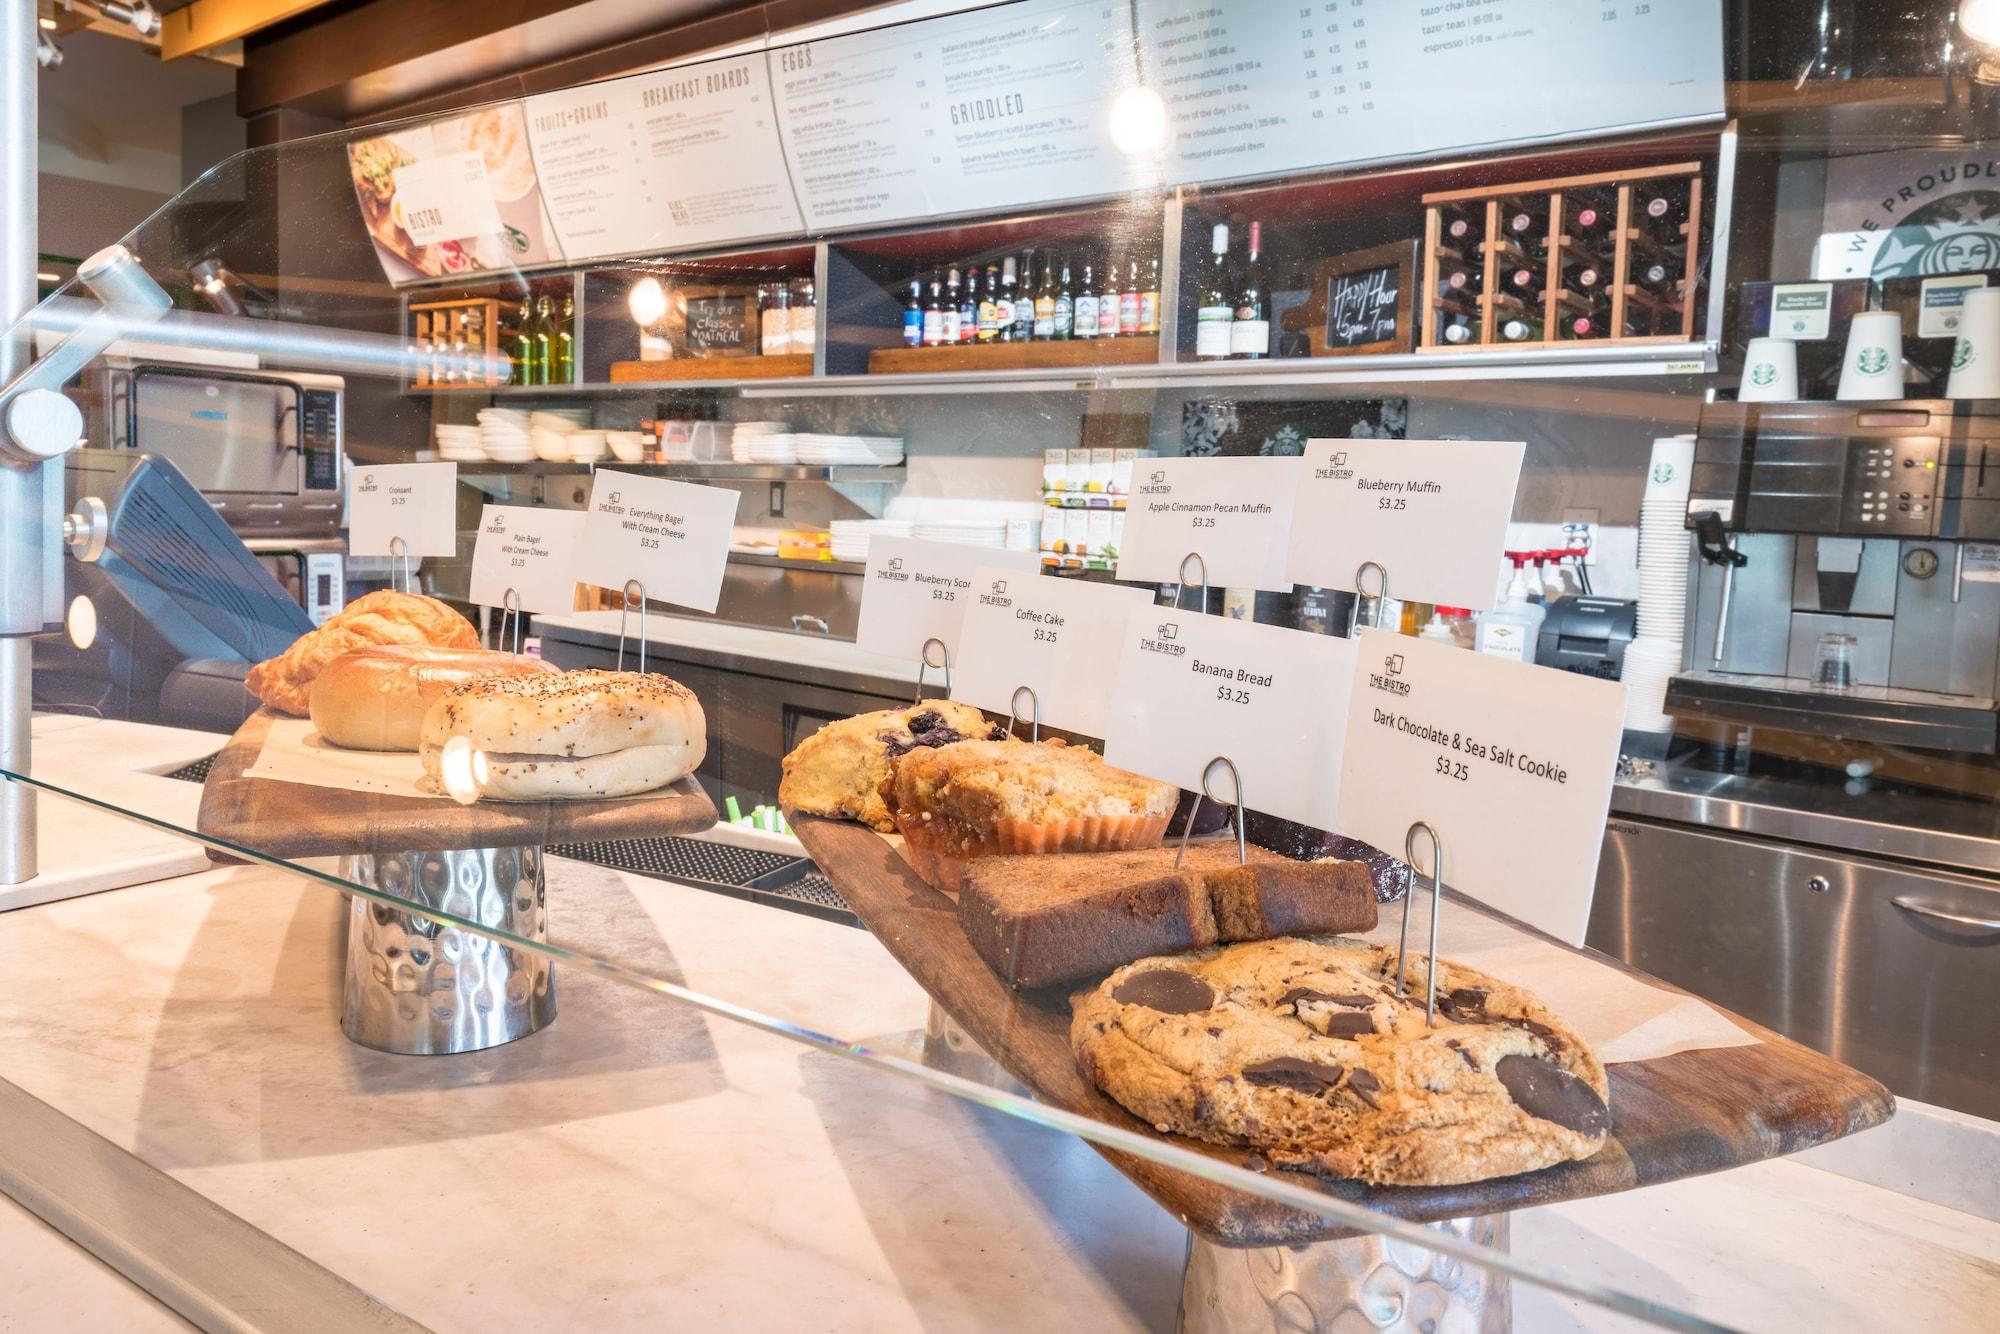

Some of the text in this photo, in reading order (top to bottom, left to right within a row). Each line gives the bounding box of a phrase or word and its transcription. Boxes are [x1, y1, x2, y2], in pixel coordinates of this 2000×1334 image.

[1424, 40, 1463, 53] espresso
[782, 48, 812, 72] EGGS
[642, 66, 750, 108] BREAKFAST BOARDS
[950, 94, 1024, 125] GRIDDLED
[408, 208, 442, 230] BISTRO
[1847, 218, 1880, 252] WE
[1329, 470, 1354, 478] BISTRO
[1358, 478, 1441, 493] Blueberry Muffin
[1148, 502, 1272, 514] Apple Cinnamon Pecan Muffin
[1379, 497, 1406, 511] $3.25
[630, 508, 684, 525] Everything Bagel
[1192, 518, 1216, 528] $3.25
[622, 520, 685, 539] With Cream Cheese
[514, 534, 541, 544] Plain Bagel
[640, 537, 659, 549] $3.25
[514, 546, 529, 555] Cream
[530, 548, 548, 557] Cheese
[512, 558, 525, 567] $3.25
[888, 572, 909, 580] BISTRO
[916, 573, 952, 587] Blueberry
[933, 590, 955, 601] $3.25
[980, 594, 1012, 606] THE BISTRO
[1016, 609, 1065, 626] Coffee Cake
[1034, 628, 1057, 643] $3.25
[1141, 638, 1155, 649] THE
[1156, 642, 1186, 655] BISTRO
[1192, 660, 1273, 687] Banana Bread
[1370, 674, 1411, 693] THE BISTRO
[1217, 686, 1250, 705] $3.25
[1374, 708, 1568, 785] Dark Chocolate & Sea Salt Cookie
[1436, 754, 1470, 781] $3.25
